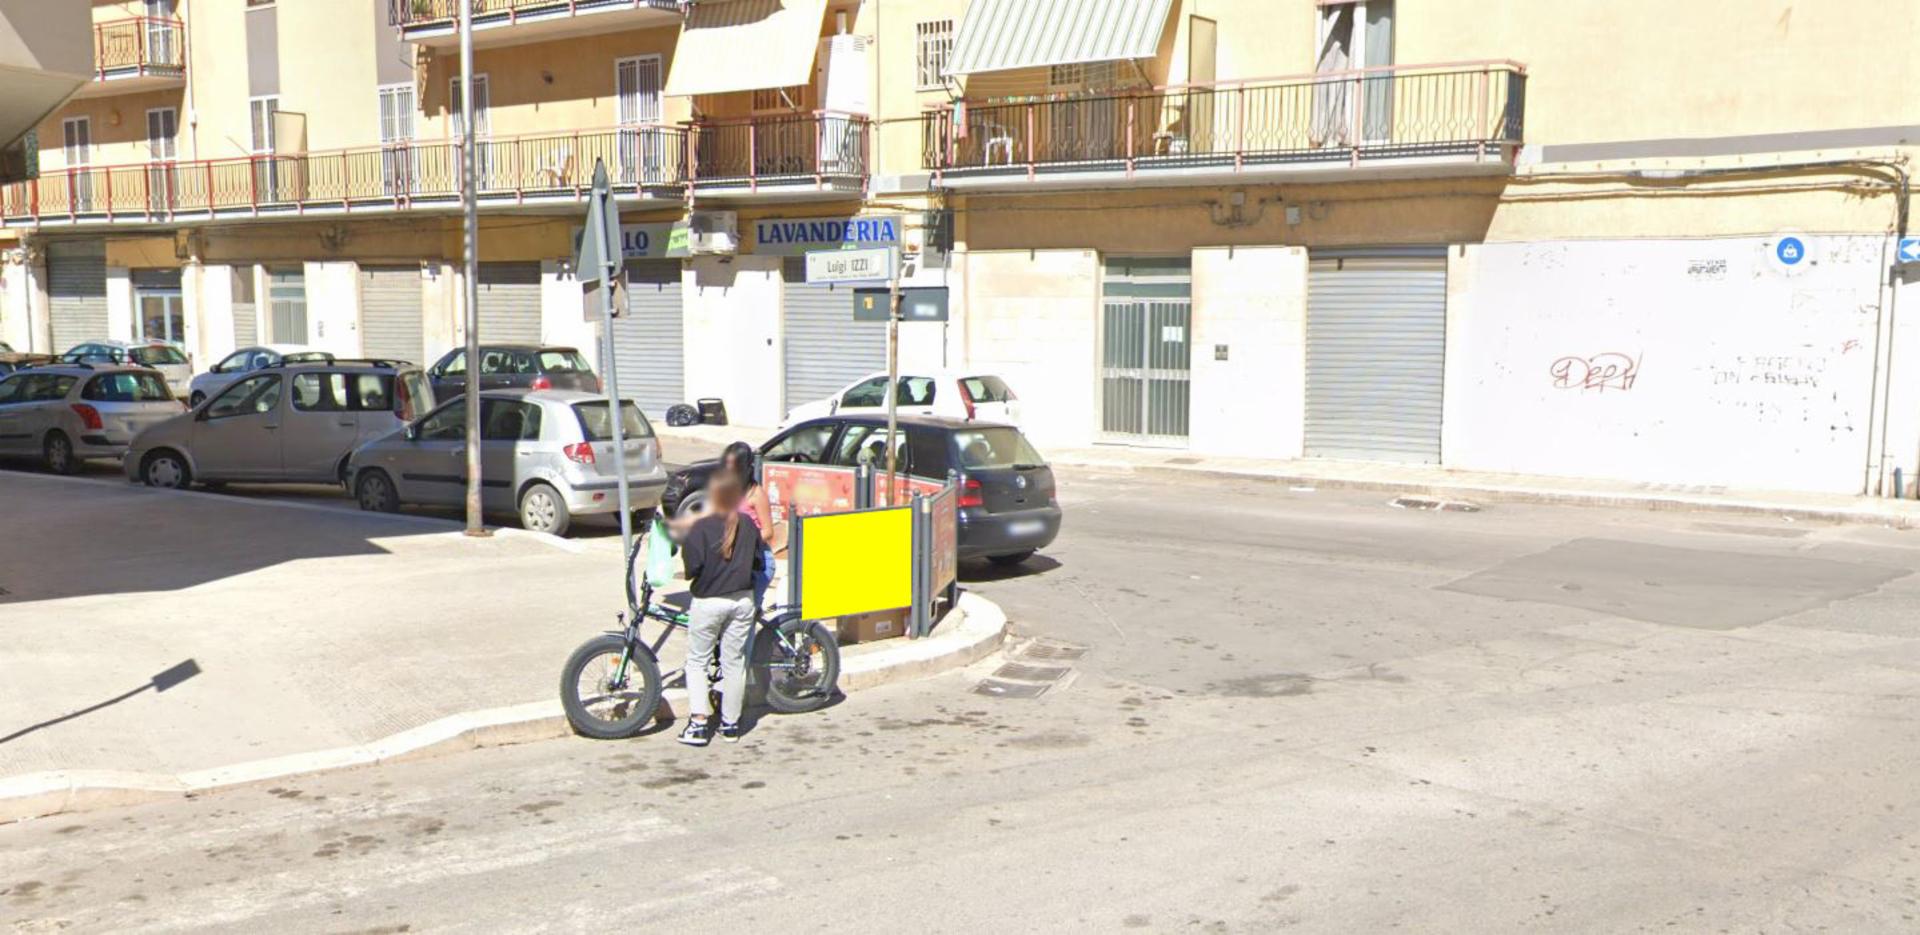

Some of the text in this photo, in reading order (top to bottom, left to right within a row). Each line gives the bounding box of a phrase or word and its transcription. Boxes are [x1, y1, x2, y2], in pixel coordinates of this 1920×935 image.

[757, 220, 896, 244] LAVANDERIA
[827, 258, 868, 274] Luigi IZZI
